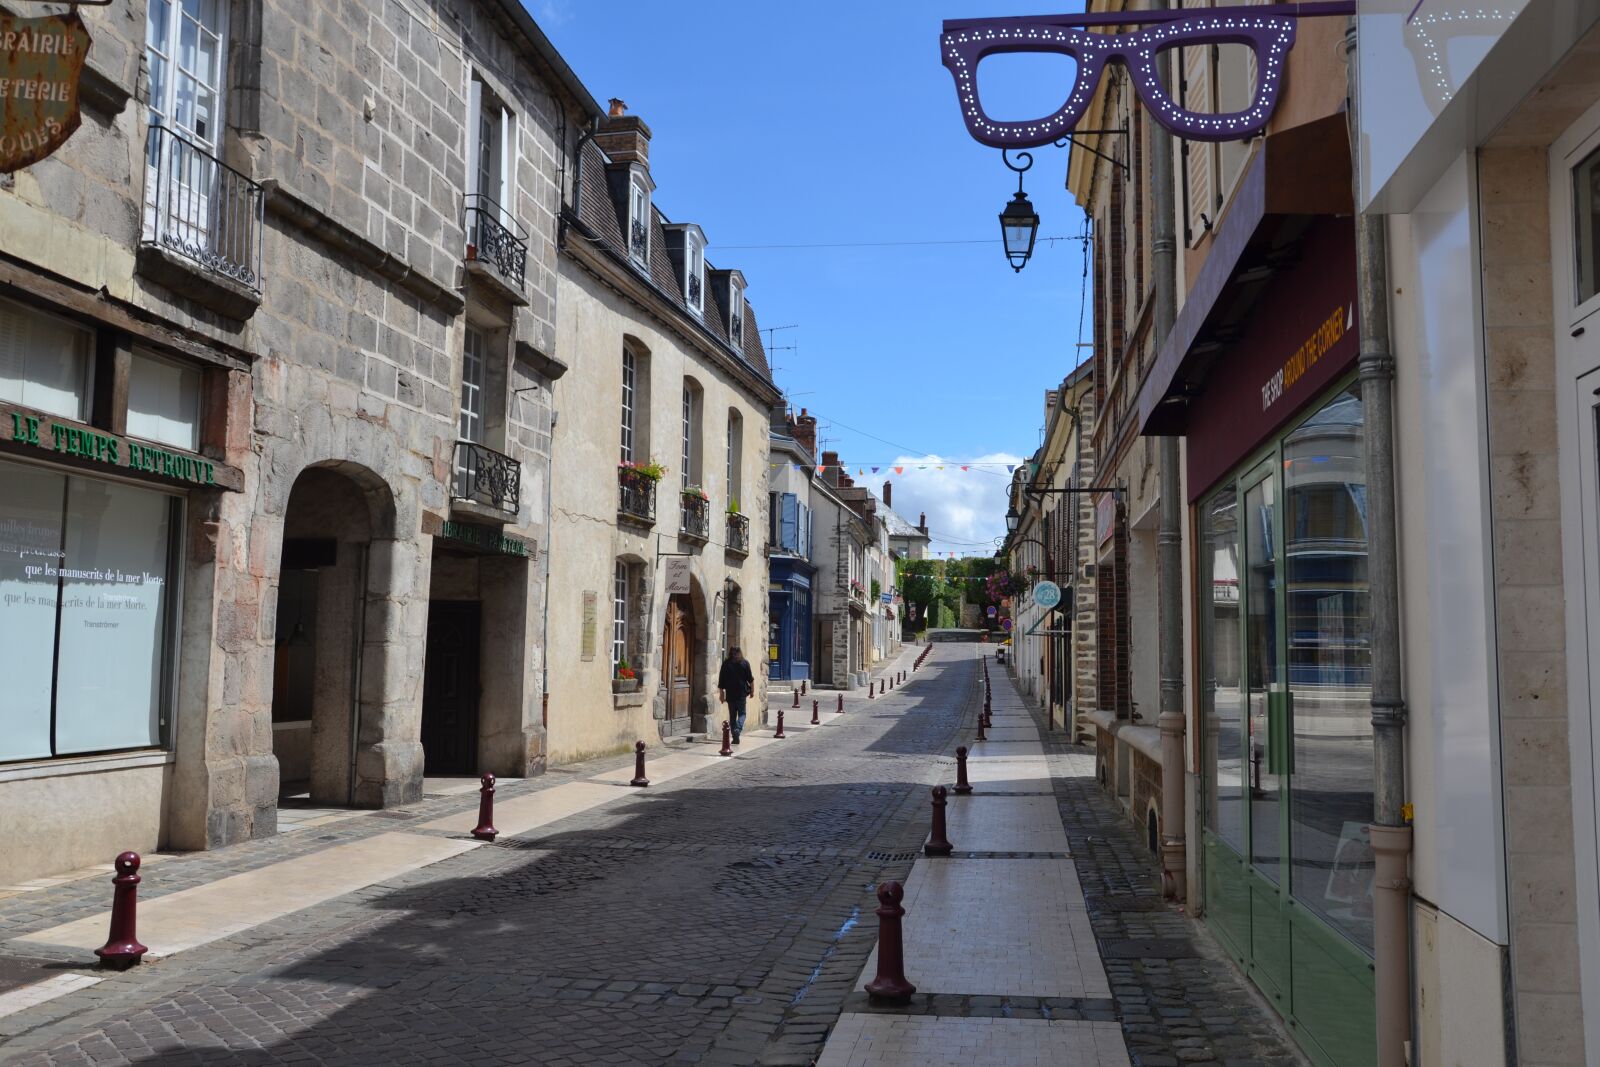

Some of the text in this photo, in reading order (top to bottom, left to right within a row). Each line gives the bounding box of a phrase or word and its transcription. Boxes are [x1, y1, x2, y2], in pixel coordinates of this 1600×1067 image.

[0, 30, 74, 55] RAIRIE
[1262, 307, 1344, 412] THE SHOP AROUND THE CORNER
[11, 413, 216, 485] LE TEMPS RETROUVE
[25, 564, 43, 579] que
[45, 562, 57, 577] les
[59, 567, 103, 580] manuscrits
[105, 568, 115, 581] de
[116, 570, 124, 582] la
[125, 573, 141, 583] mer
[4, 592, 22, 608] que
[24, 592, 36, 606] les
